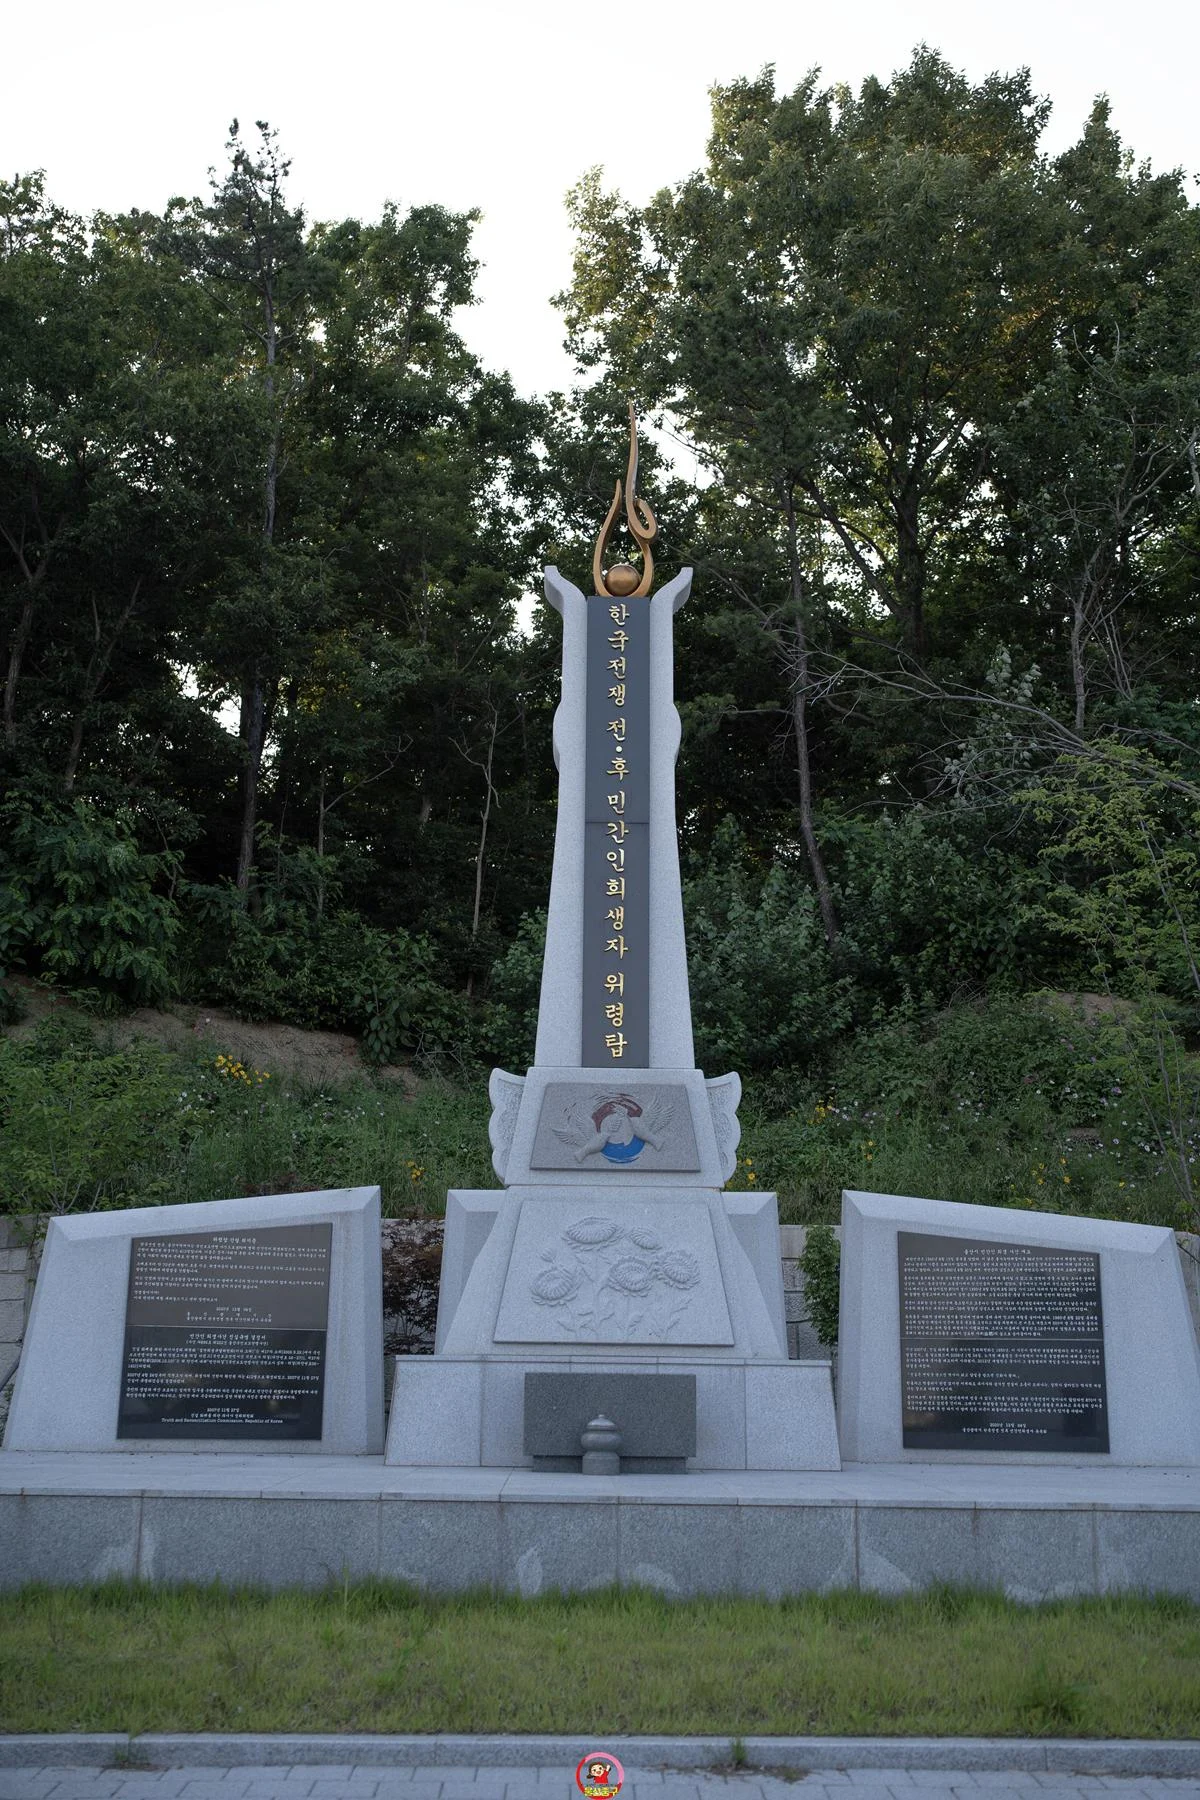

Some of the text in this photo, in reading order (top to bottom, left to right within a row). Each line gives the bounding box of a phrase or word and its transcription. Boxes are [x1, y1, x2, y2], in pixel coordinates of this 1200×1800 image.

[606, 603, 631, 707] 한국전쟁
[603, 790, 630, 960] 민간인희생자
[603, 971, 628, 1058] 위령탑
